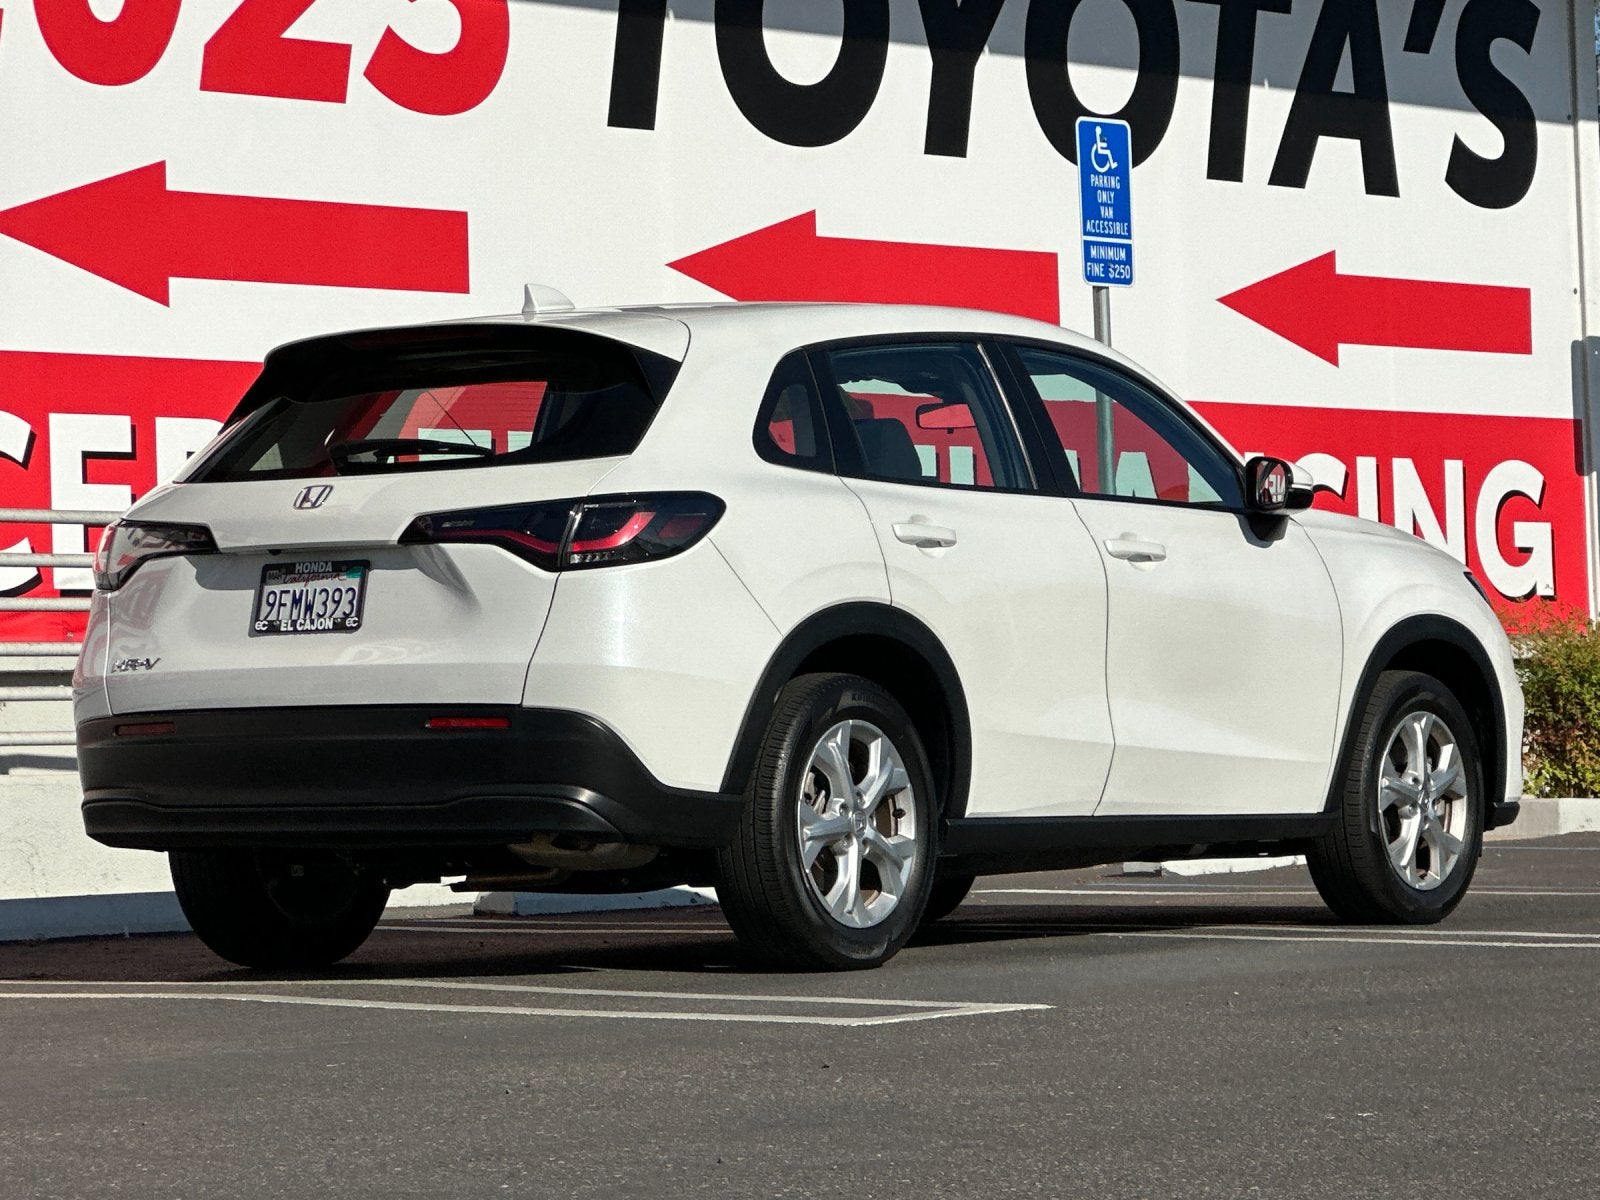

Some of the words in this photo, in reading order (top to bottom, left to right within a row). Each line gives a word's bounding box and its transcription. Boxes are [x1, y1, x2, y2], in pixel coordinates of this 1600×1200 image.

[1090, 174, 1121, 189] PARKING
[1097, 190, 1115, 204] ONLY
[1099, 206, 1114, 219] VAN
[1086, 220, 1129, 236] ACCESSIBLE
[1090, 245, 1126, 261] MINIMUM
[1087, 262, 1105, 277] FINE
[1108, 264, 1131, 279] $250
[295, 561, 333, 574] HONDA
[264, 587, 357, 620] 9FMW393
[280, 620, 294, 632] EL
[296, 617, 334, 631] CAJON
